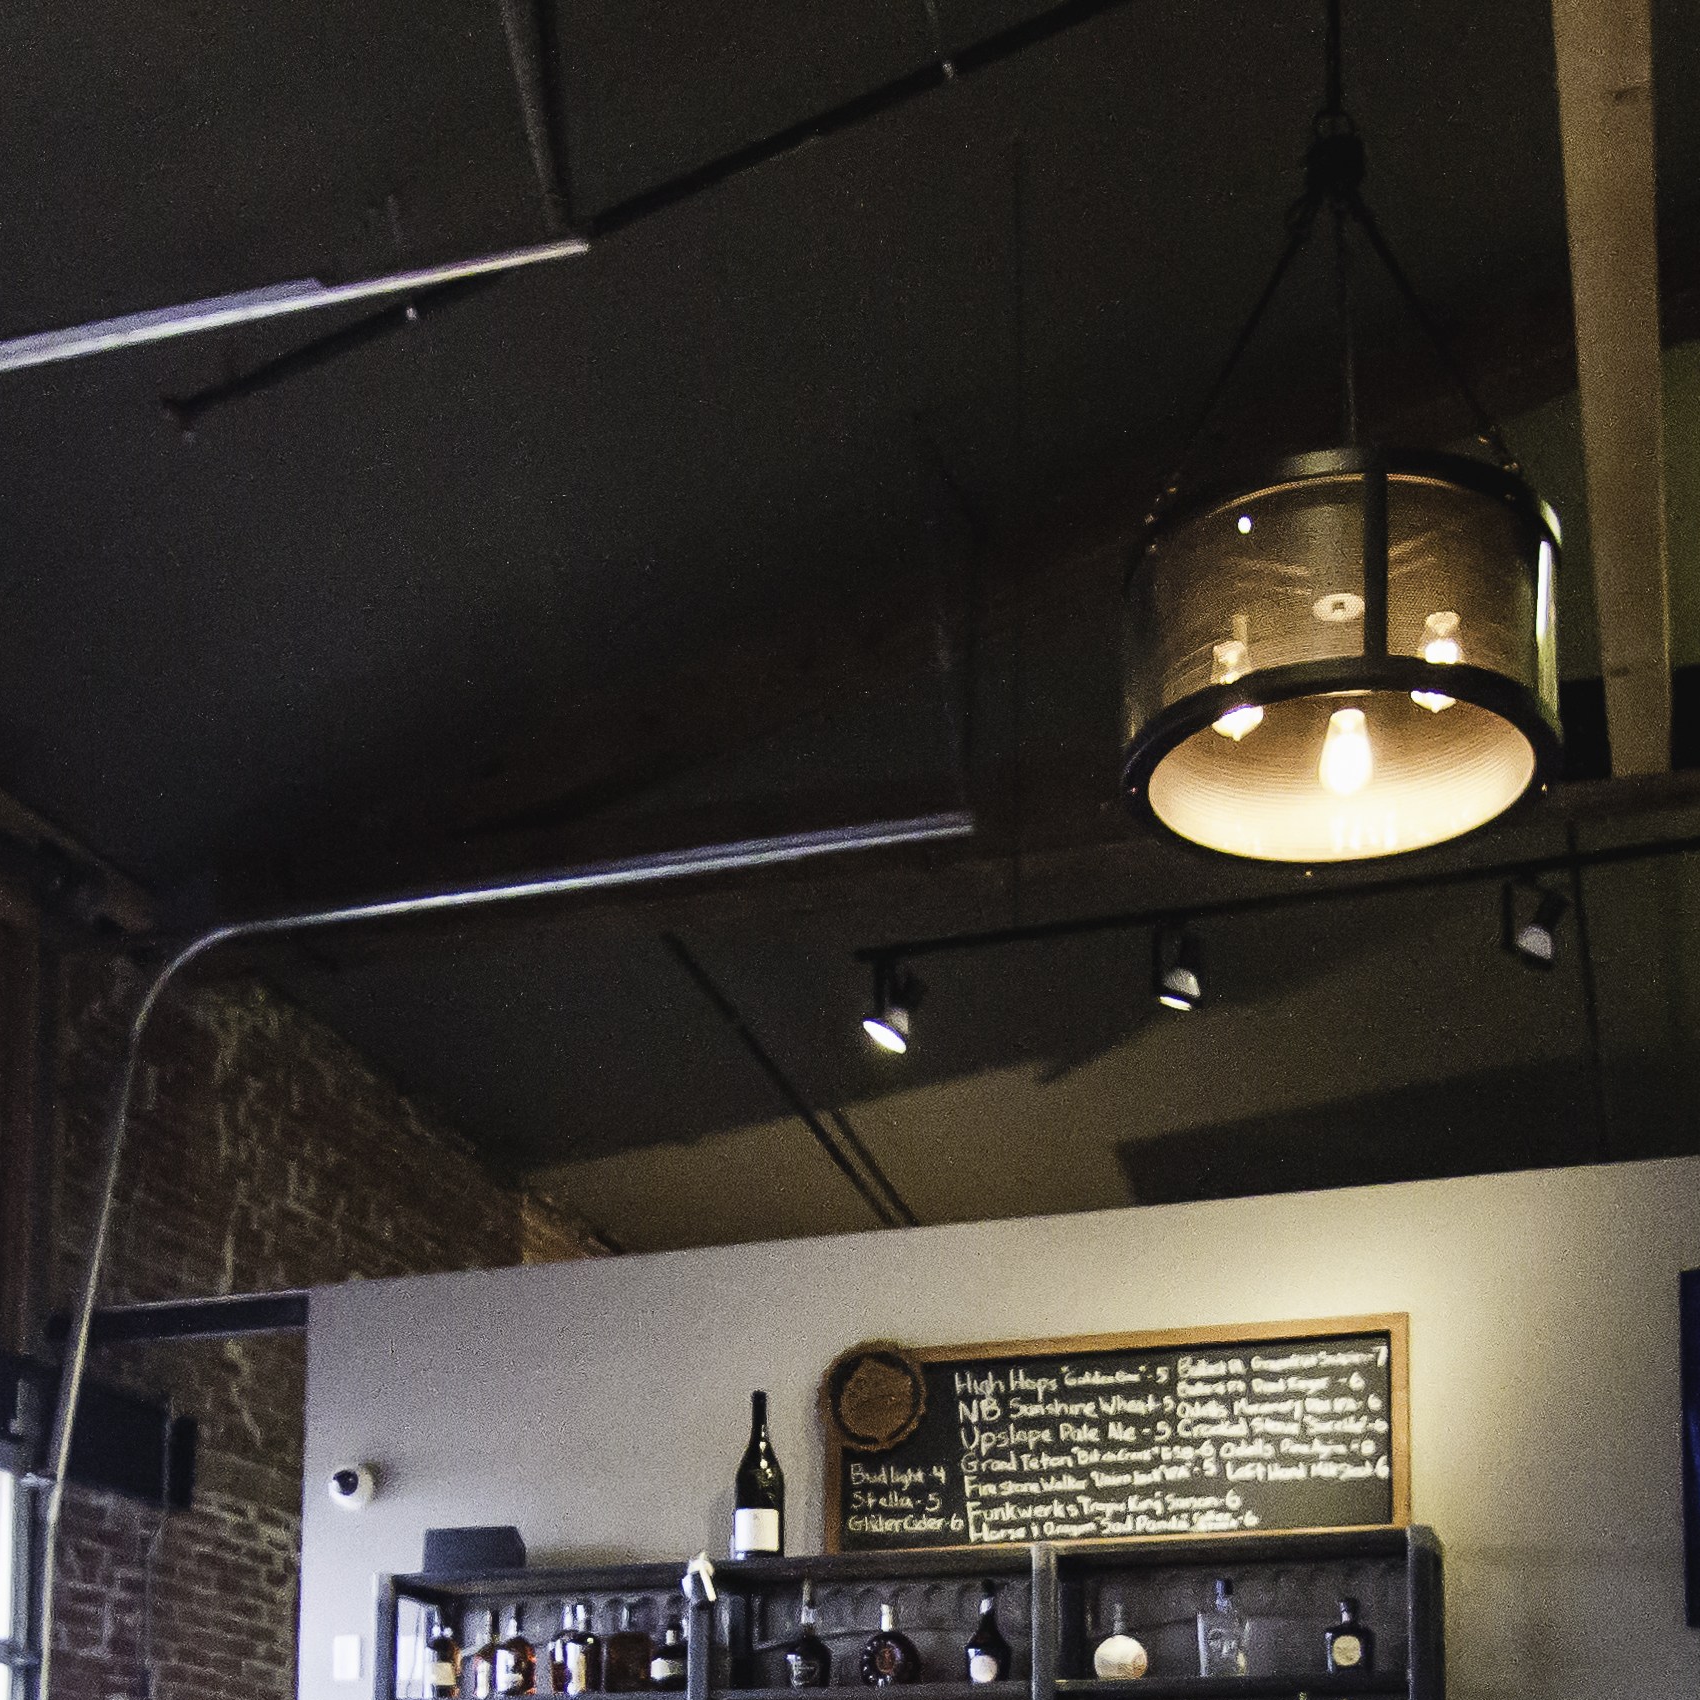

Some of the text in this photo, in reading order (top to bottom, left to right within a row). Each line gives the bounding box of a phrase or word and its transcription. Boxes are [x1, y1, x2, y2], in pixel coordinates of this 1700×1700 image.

[955, 1371, 1005, 1399] High
[1009, 1368, 1058, 1403] Hops
[959, 1398, 1001, 1423] NB
[1009, 1397, 1099, 1419] Sunshine
[1098, 1394, 1154, 1416] Wheat
[961, 1422, 1052, 1456] Upslope
[1059, 1422, 1100, 1443] Pale
[1107, 1421, 1138, 1442] Ale
[850, 1463, 887, 1485] Bud
[851, 1490, 913, 1509] Stella
[966, 1499, 1079, 1522] Funkwerks
